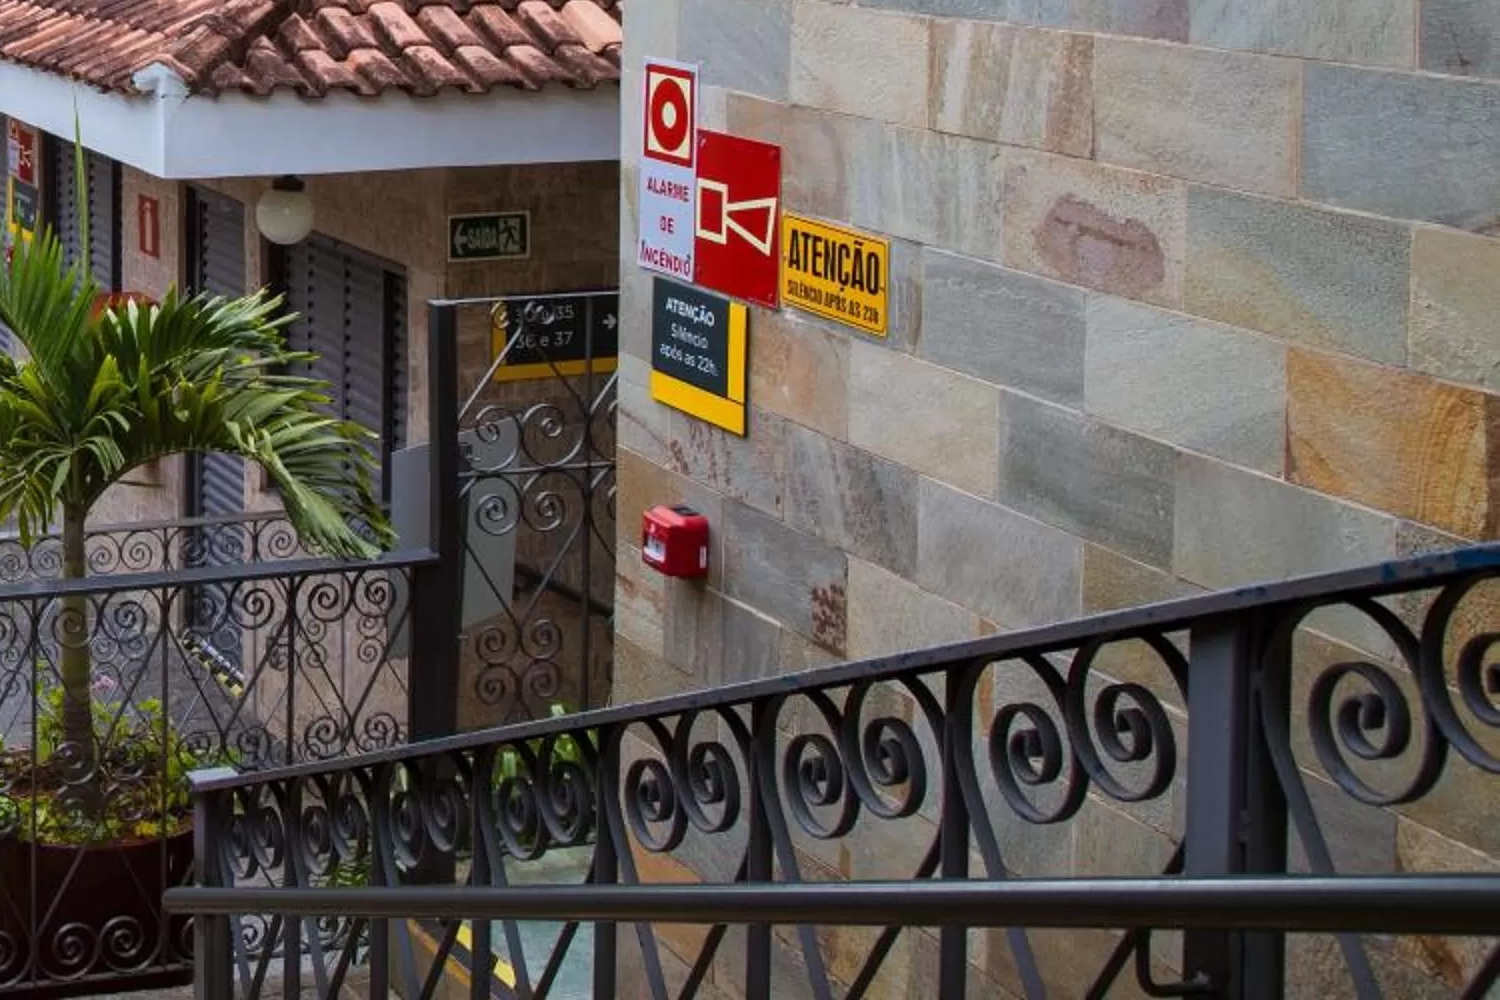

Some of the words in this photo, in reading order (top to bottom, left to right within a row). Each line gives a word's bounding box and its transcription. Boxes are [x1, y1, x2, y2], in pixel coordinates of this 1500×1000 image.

[647, 177, 690, 203] ALARME
[660, 215, 675, 234] DE
[788, 227, 880, 296] ATENÇÃO
[555, 304, 575, 321] 35
[665, 296, 715, 328] ATENÇÃO
[540, 335, 550, 348] e
[554, 330, 574, 346] 37
